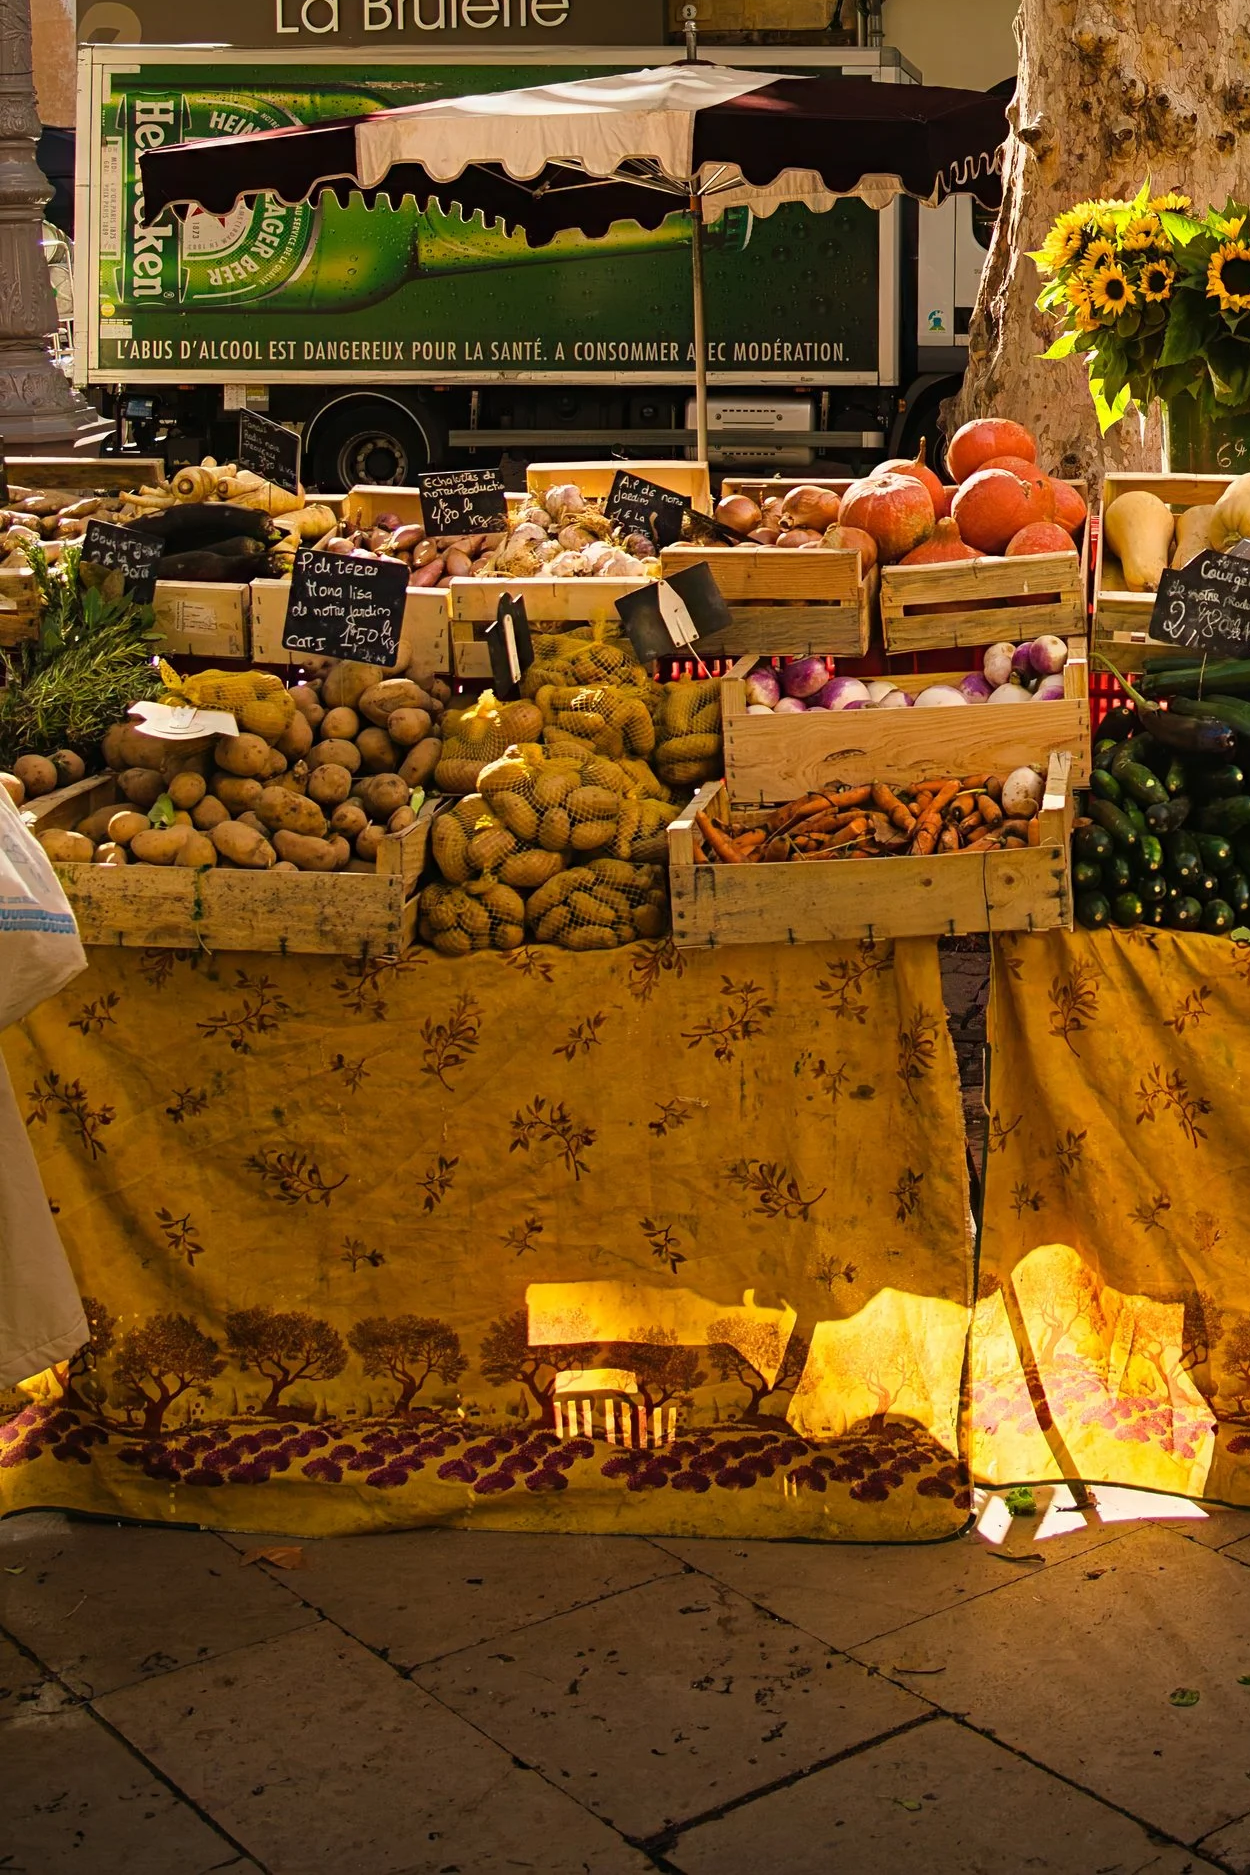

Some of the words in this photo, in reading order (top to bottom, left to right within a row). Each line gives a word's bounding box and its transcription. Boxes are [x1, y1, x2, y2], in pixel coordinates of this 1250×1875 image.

[132, 99, 175, 298] Heken
[207, 254, 261, 286] BEER
[116, 340, 173, 360] L'ABUS
[180, 340, 263, 361] D'ALCOOL
[269, 341, 297, 361] EST
[304, 341, 404, 361] DANGEREUX
[412, 341, 457, 361] POUR
[465, 342, 484, 361] LA
[491, 338, 548, 361] SANTÉ.
[555, 342, 565, 361] A
[574, 342, 679, 362] CONSOMMER
[687, 342, 726, 362] AEC
[733, 338, 850, 362] MODÉRATION.
